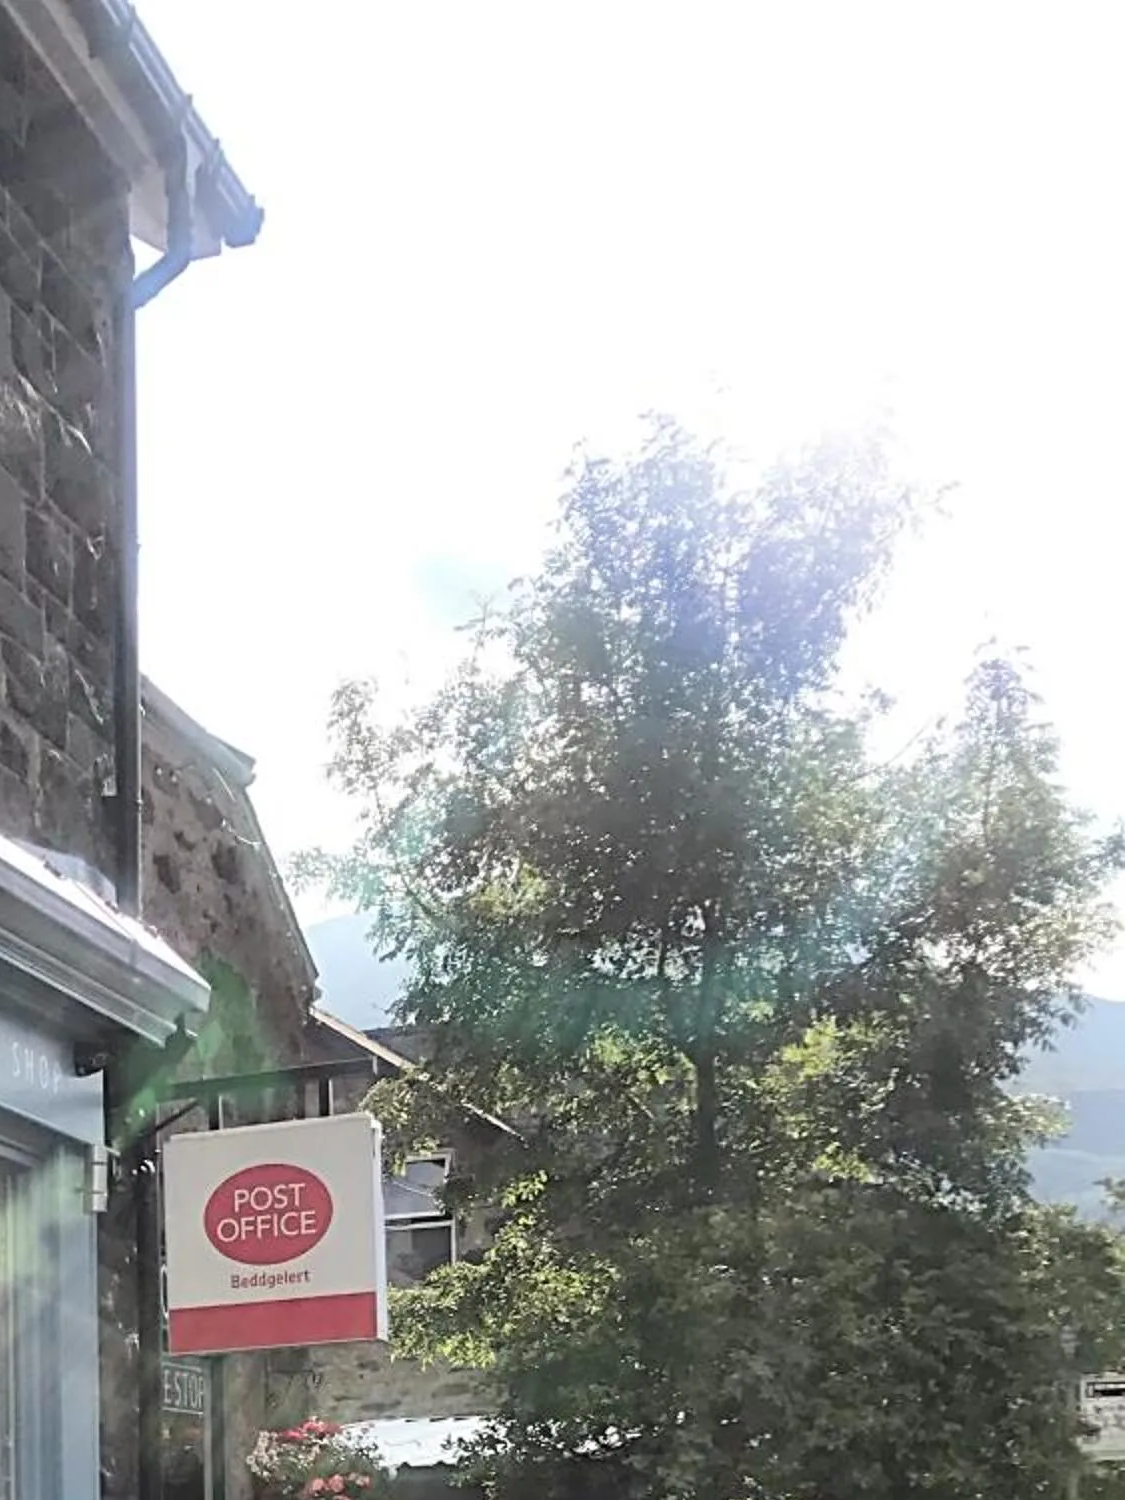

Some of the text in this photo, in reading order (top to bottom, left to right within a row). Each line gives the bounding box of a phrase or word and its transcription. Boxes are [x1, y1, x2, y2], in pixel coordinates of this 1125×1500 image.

[11, 1041, 63, 1095] SHOP
[234, 1183, 306, 1212] POST
[216, 1210, 317, 1243] OFFICE
[230, 1270, 311, 1289] Beddgelert
